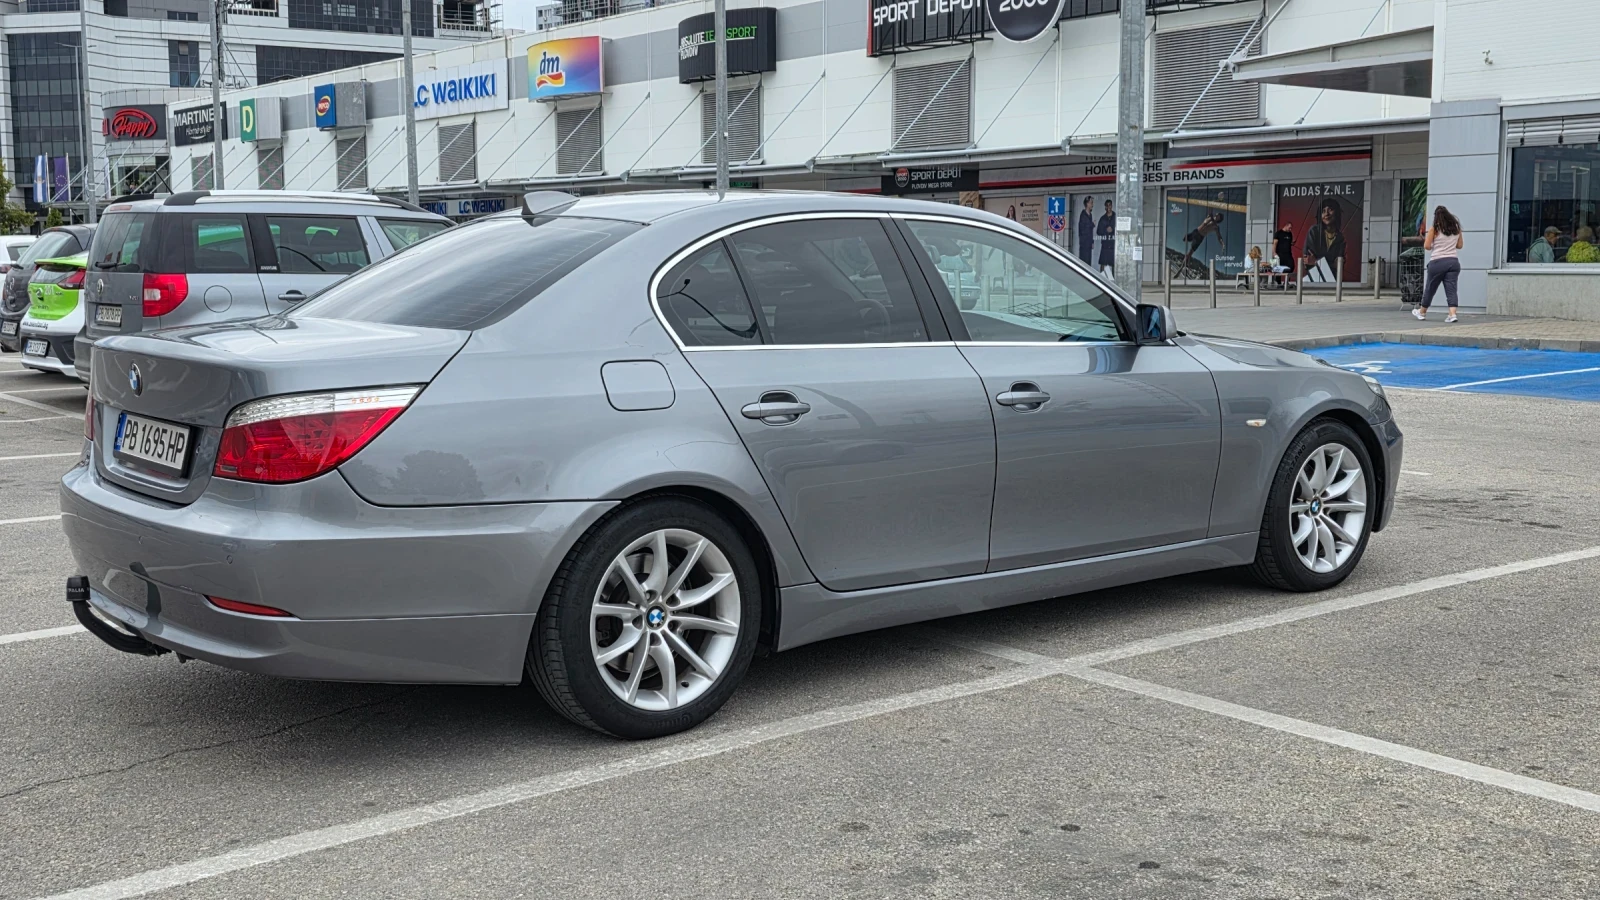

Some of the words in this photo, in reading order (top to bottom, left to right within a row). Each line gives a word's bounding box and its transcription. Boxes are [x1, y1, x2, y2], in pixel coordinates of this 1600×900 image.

[874, 1, 919, 27] SPORT
[540, 51, 560, 76] dm
[413, 85, 429, 108] C
[114, 115, 151, 137] Happy
[242, 105, 254, 133] D
[911, 170, 936, 181] SPORT
[937, 168, 961, 179] DEPOT
[1085, 164, 1117, 175] HOME
[1173, 168, 1224, 181] BRANDS
[1283, 185, 1320, 197] ADIDAS
[1323, 184, 1355, 195] Z.N.E.
[459, 201, 471, 213] LC
[122, 419, 138, 450] PB
[140, 424, 167, 458] 1695
[166, 430, 185, 463] HP
